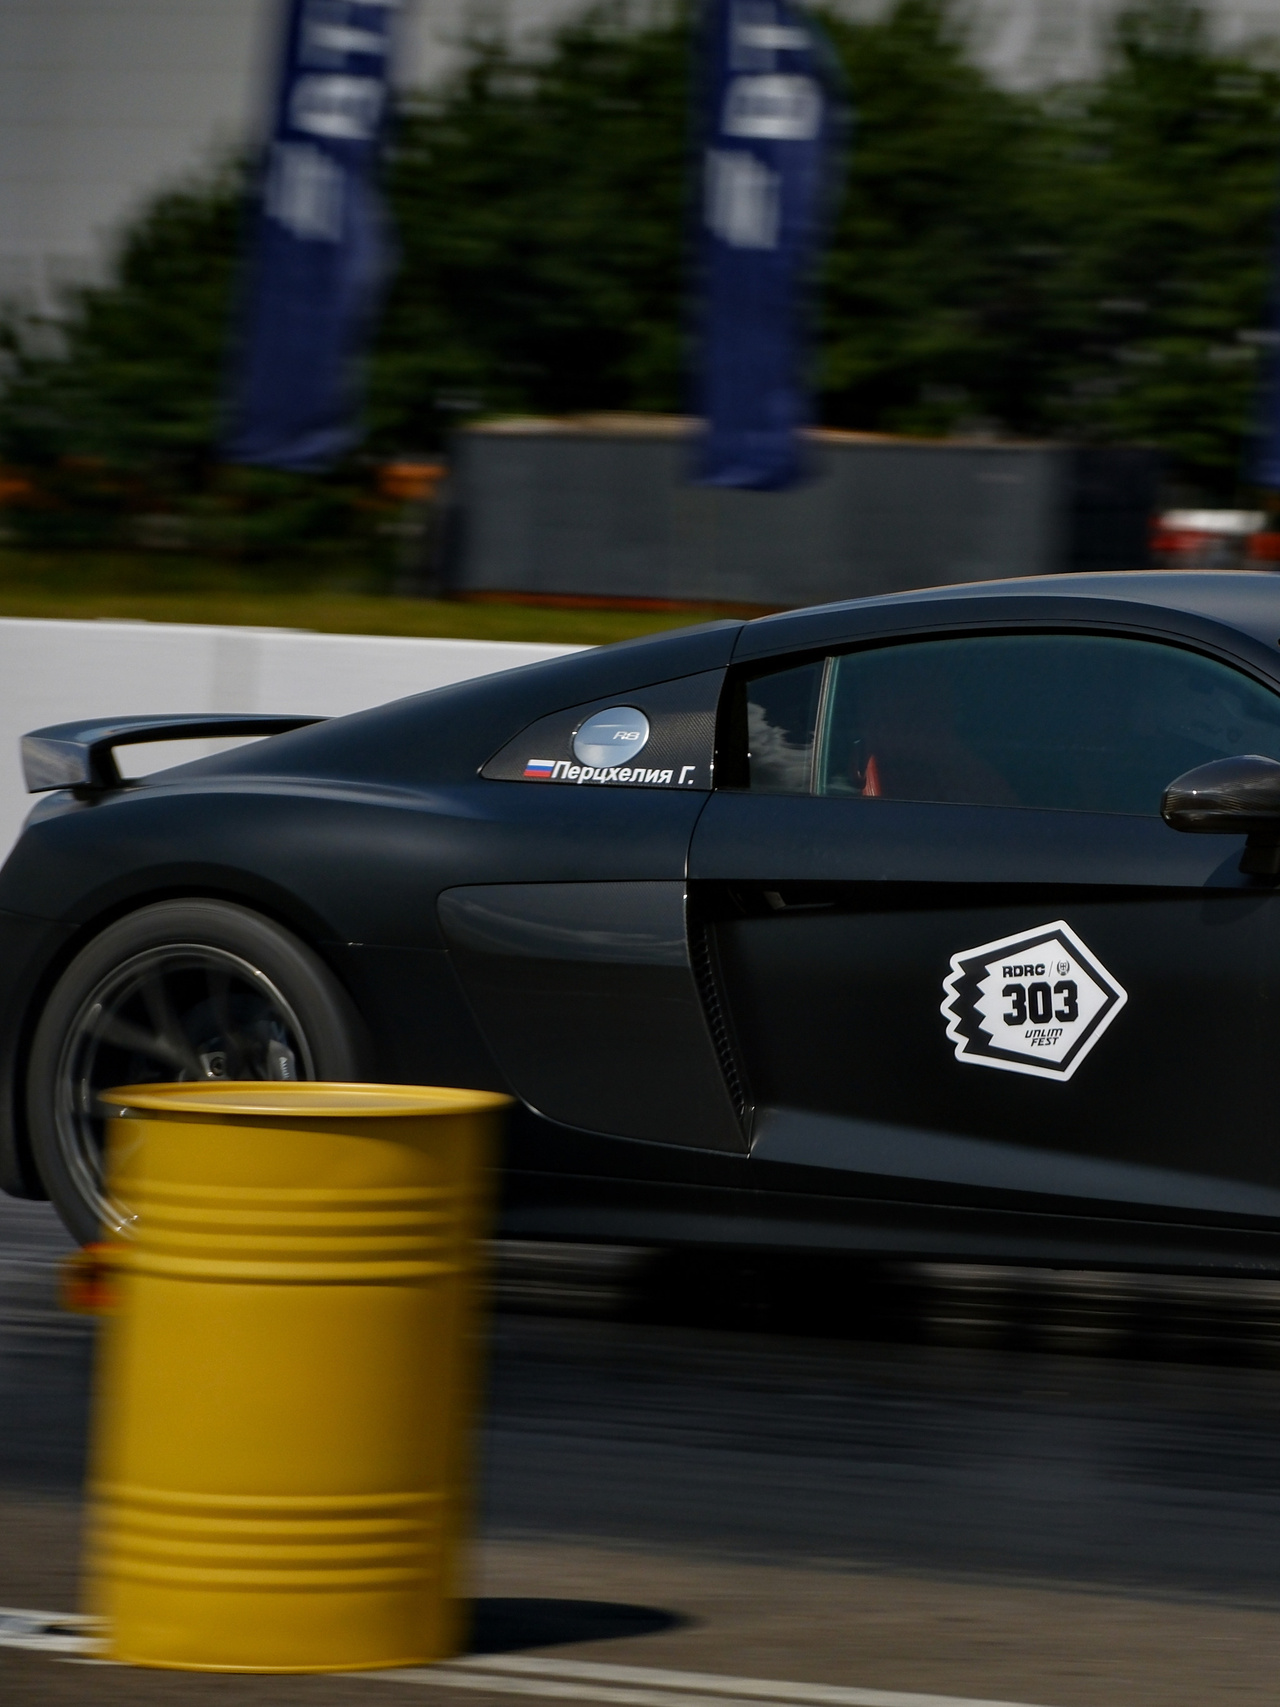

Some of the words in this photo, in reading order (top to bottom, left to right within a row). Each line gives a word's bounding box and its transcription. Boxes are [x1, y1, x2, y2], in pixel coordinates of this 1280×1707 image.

[551, 761, 674, 784] Перцхелия
[678, 766, 696, 785] Г.
[1002, 963, 1046, 978] RDRC
[1002, 980, 1079, 1026] 303
[1025, 1028, 1063, 1039] UNLIM
[1031, 1037, 1059, 1047] FEST
